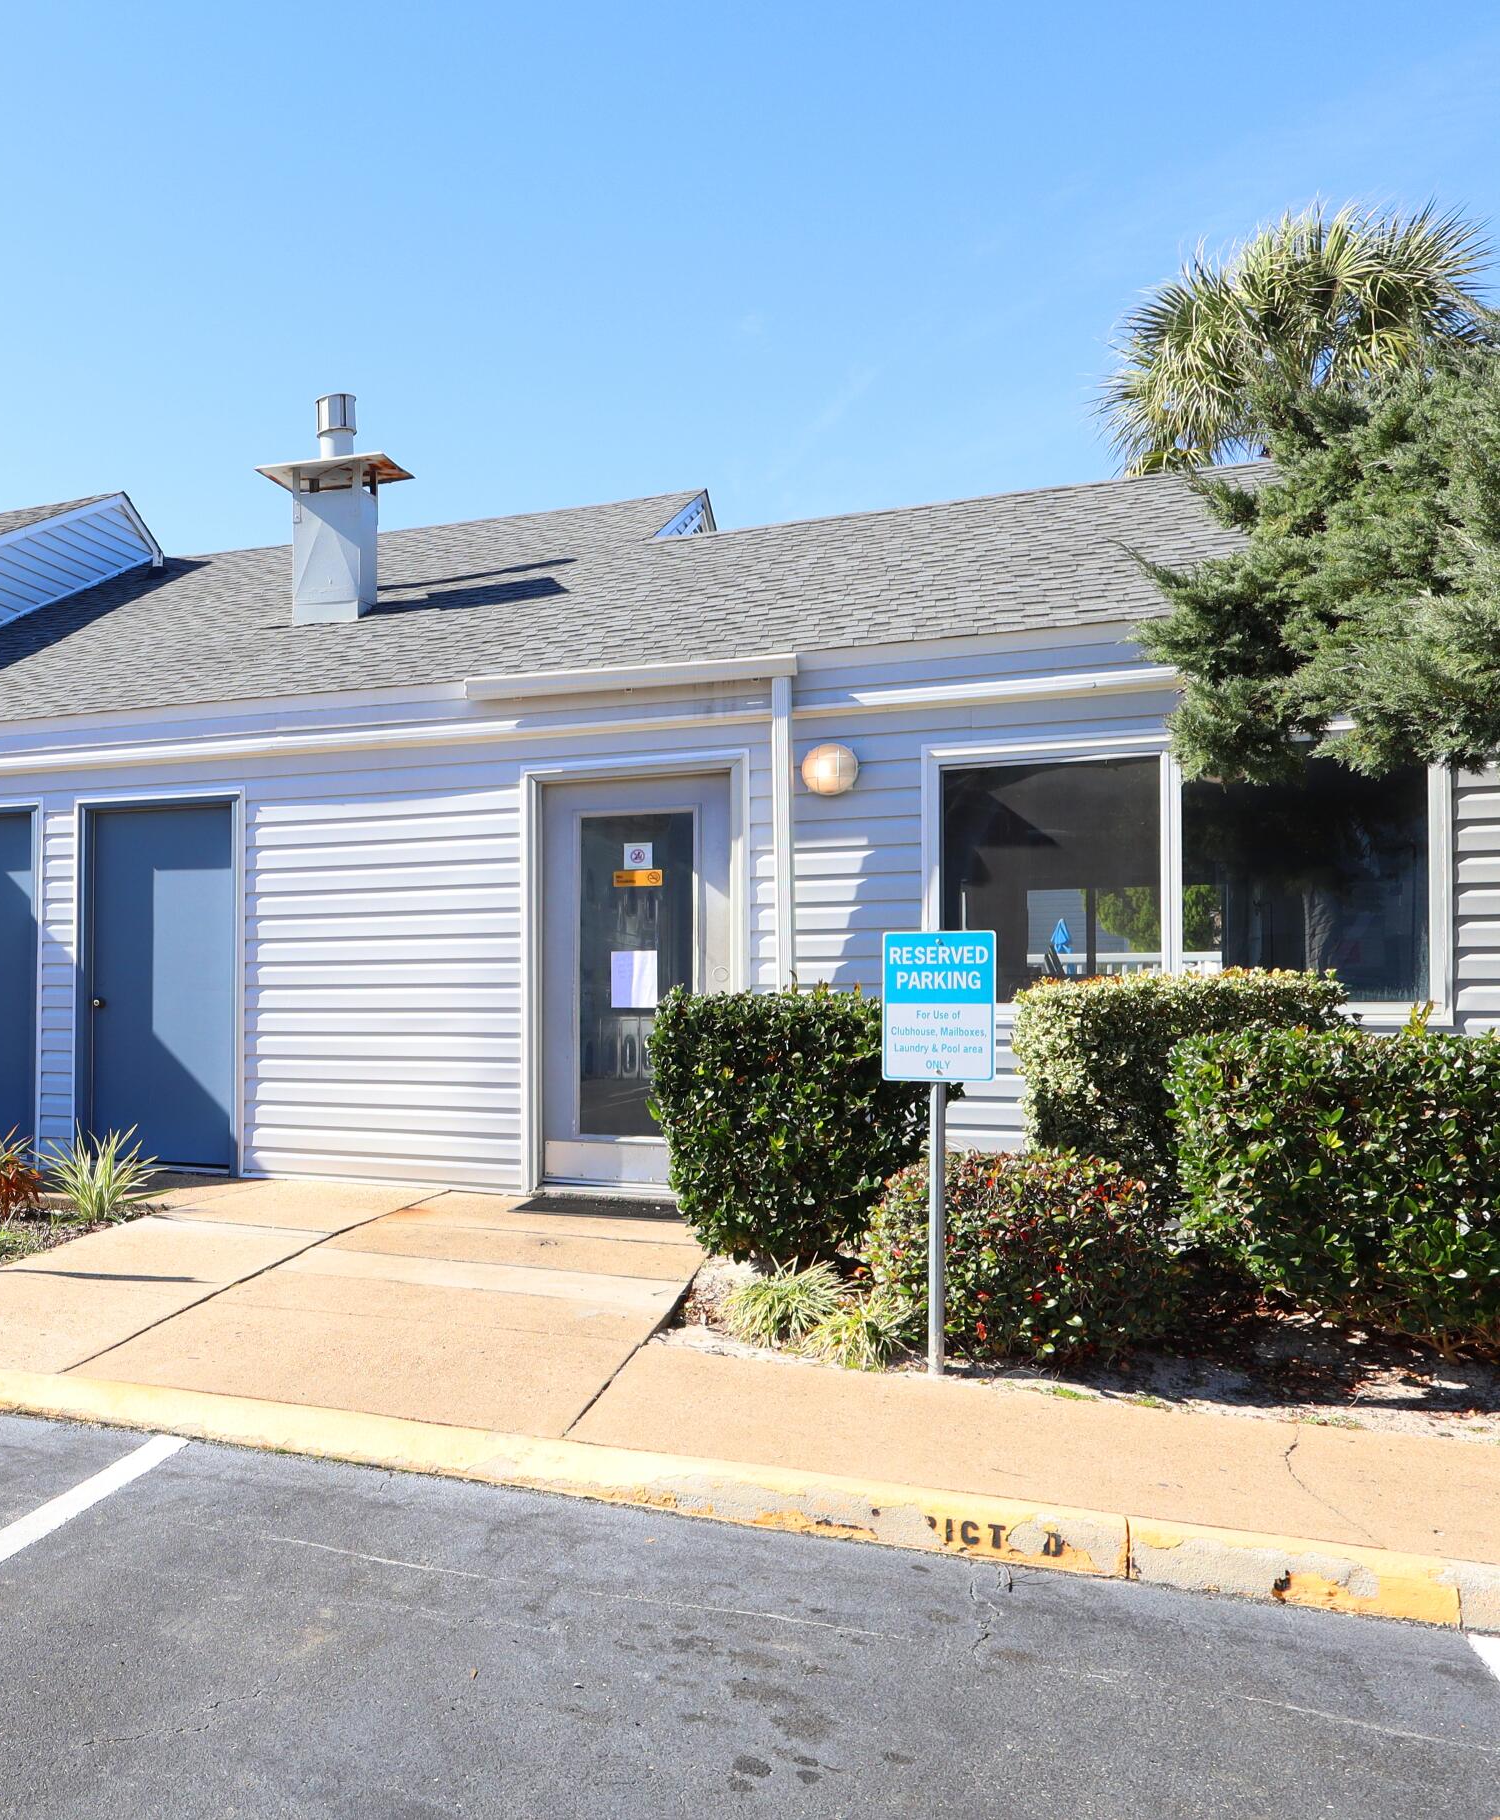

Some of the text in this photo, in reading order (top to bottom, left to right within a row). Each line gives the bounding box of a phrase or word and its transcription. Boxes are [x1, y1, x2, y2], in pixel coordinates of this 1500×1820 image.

[889, 946, 989, 965] RESERVED
[896, 971, 981, 990] PARKING
[916, 1010, 961, 1020] For Use of
[891, 1027, 987, 1038] Clubhouse, Mailboxes,
[894, 1043, 983, 1056] Laundry & Pool area
[925, 1060, 950, 1070] ONLY
